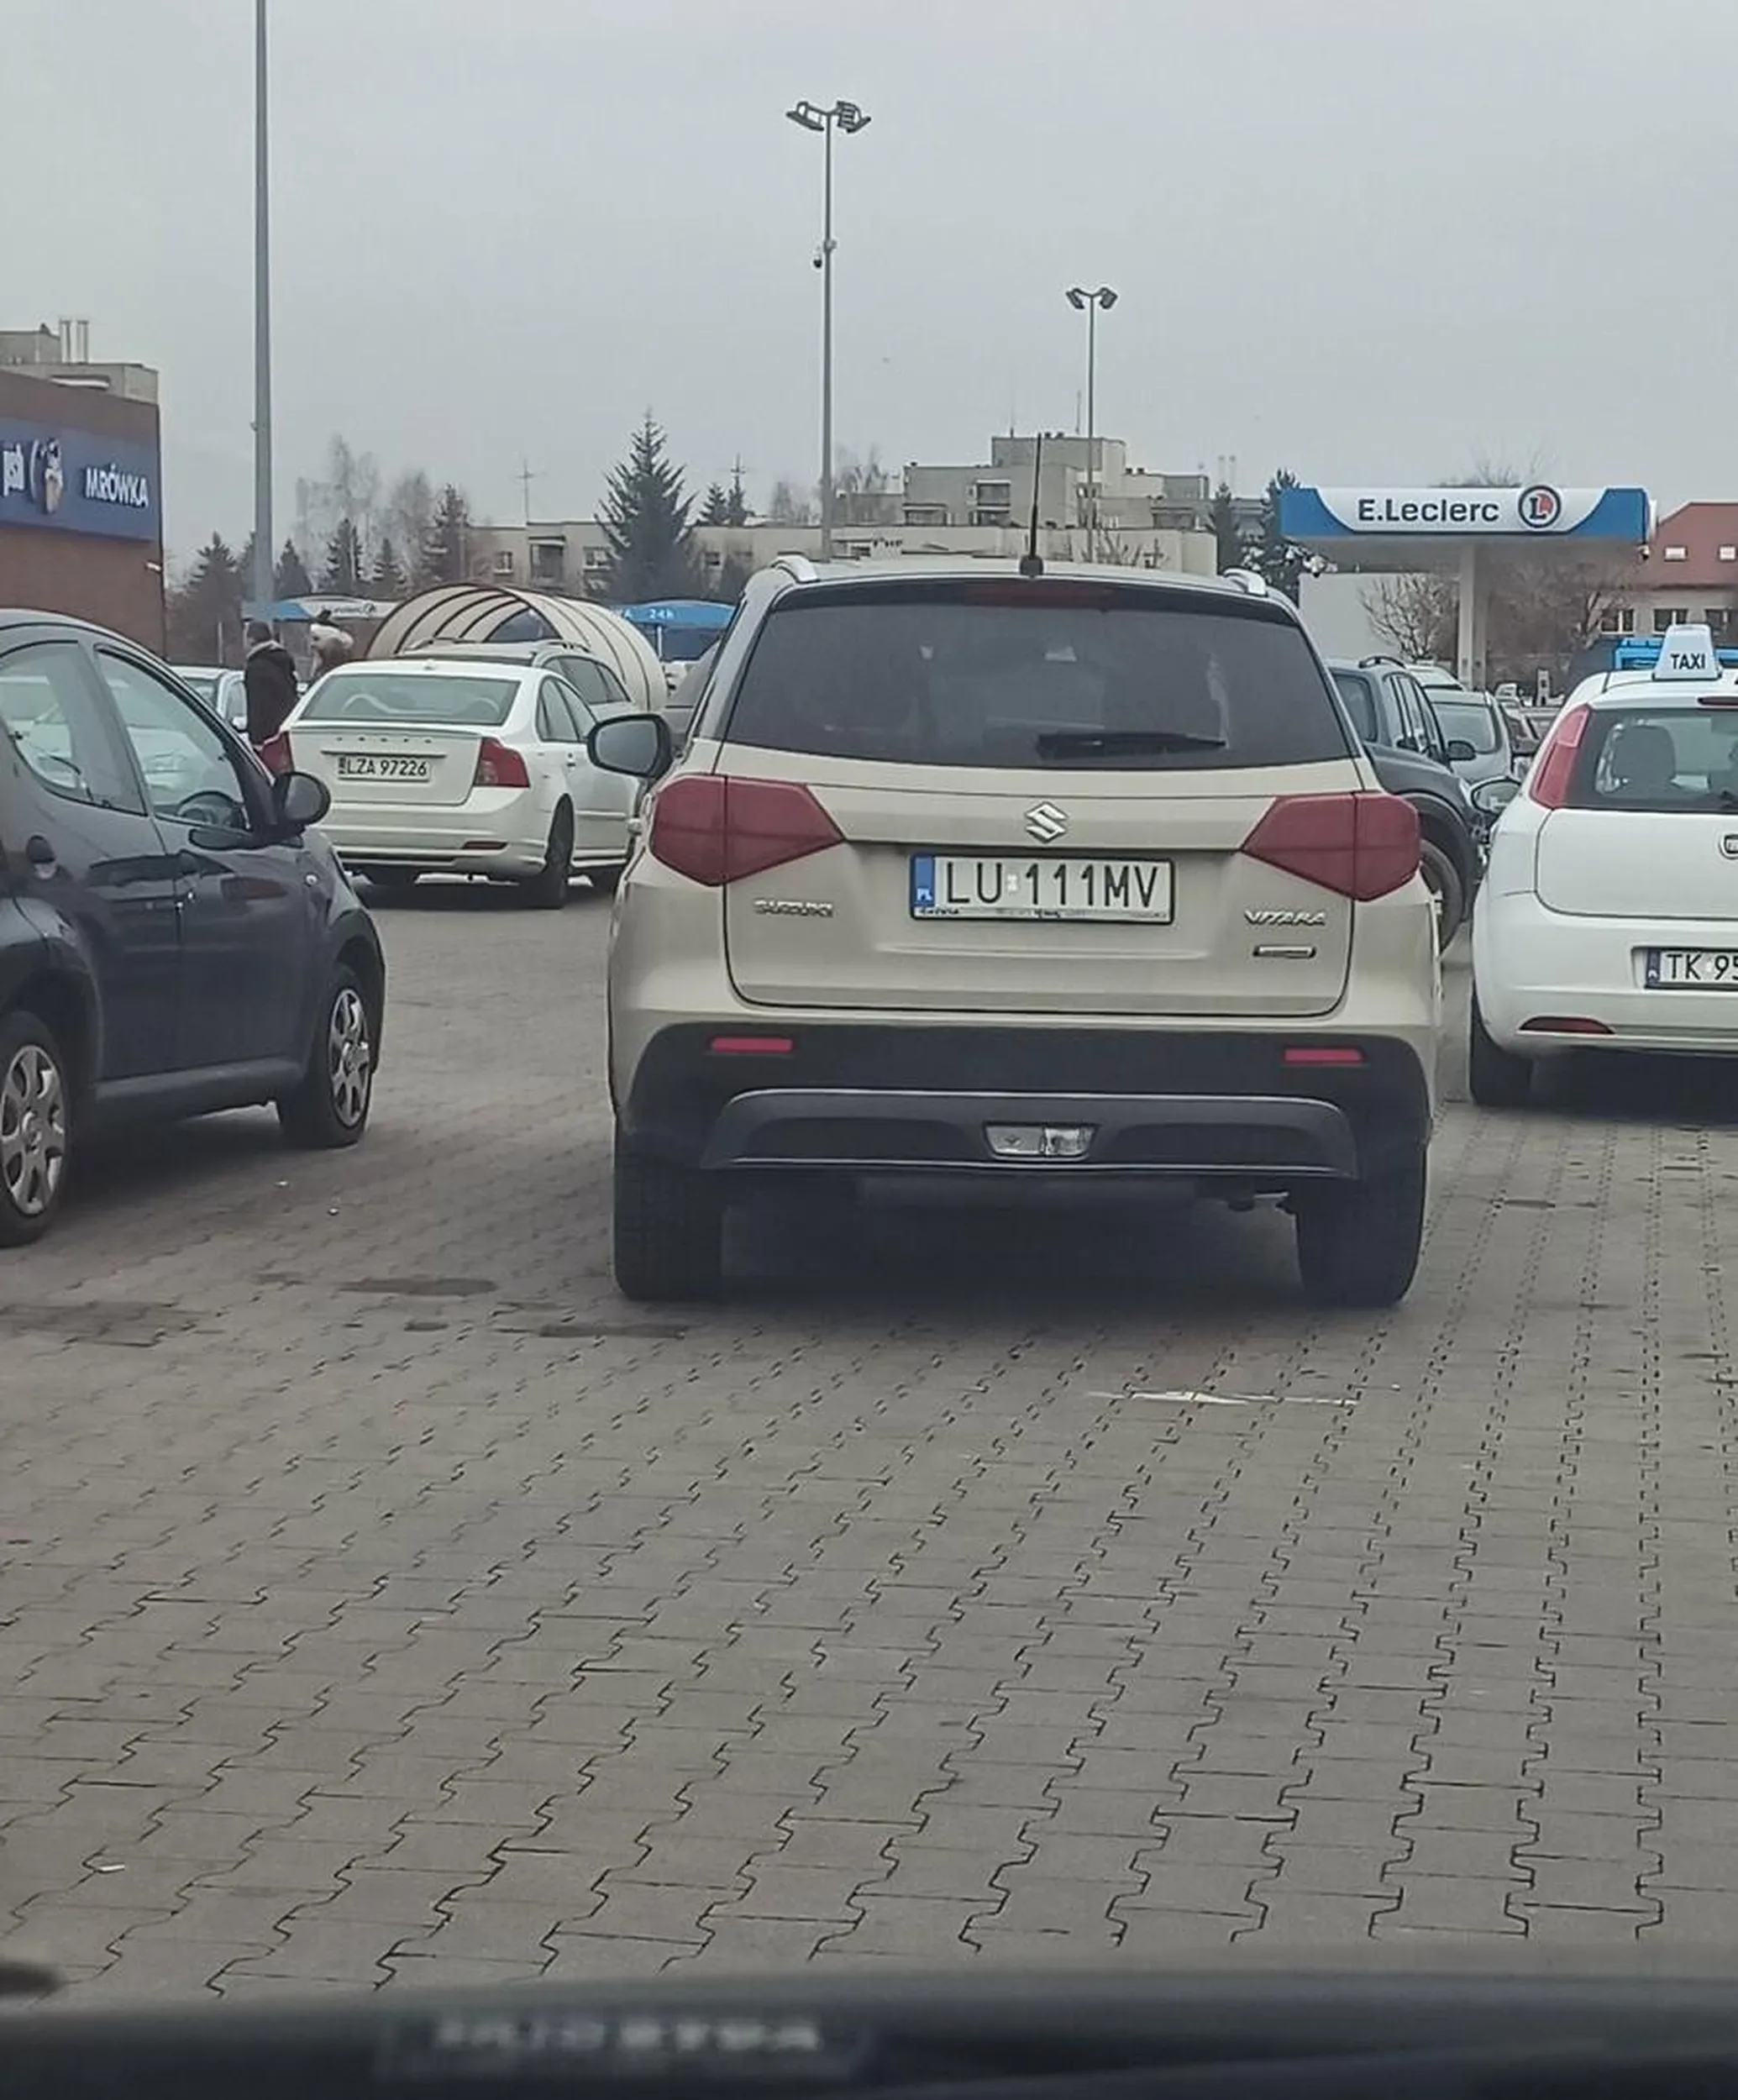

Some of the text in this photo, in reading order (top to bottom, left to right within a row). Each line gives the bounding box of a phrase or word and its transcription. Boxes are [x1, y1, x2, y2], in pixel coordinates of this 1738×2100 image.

[85, 463, 149, 507] MRÓWKA
[1357, 499, 1499, 522] E.Leclerc
[1670, 653, 1706, 669] TAXI
[347, 759, 427, 776] LZA 97226
[947, 862, 1158, 907] LU 111MV
[1666, 954, 1701, 980] TK
